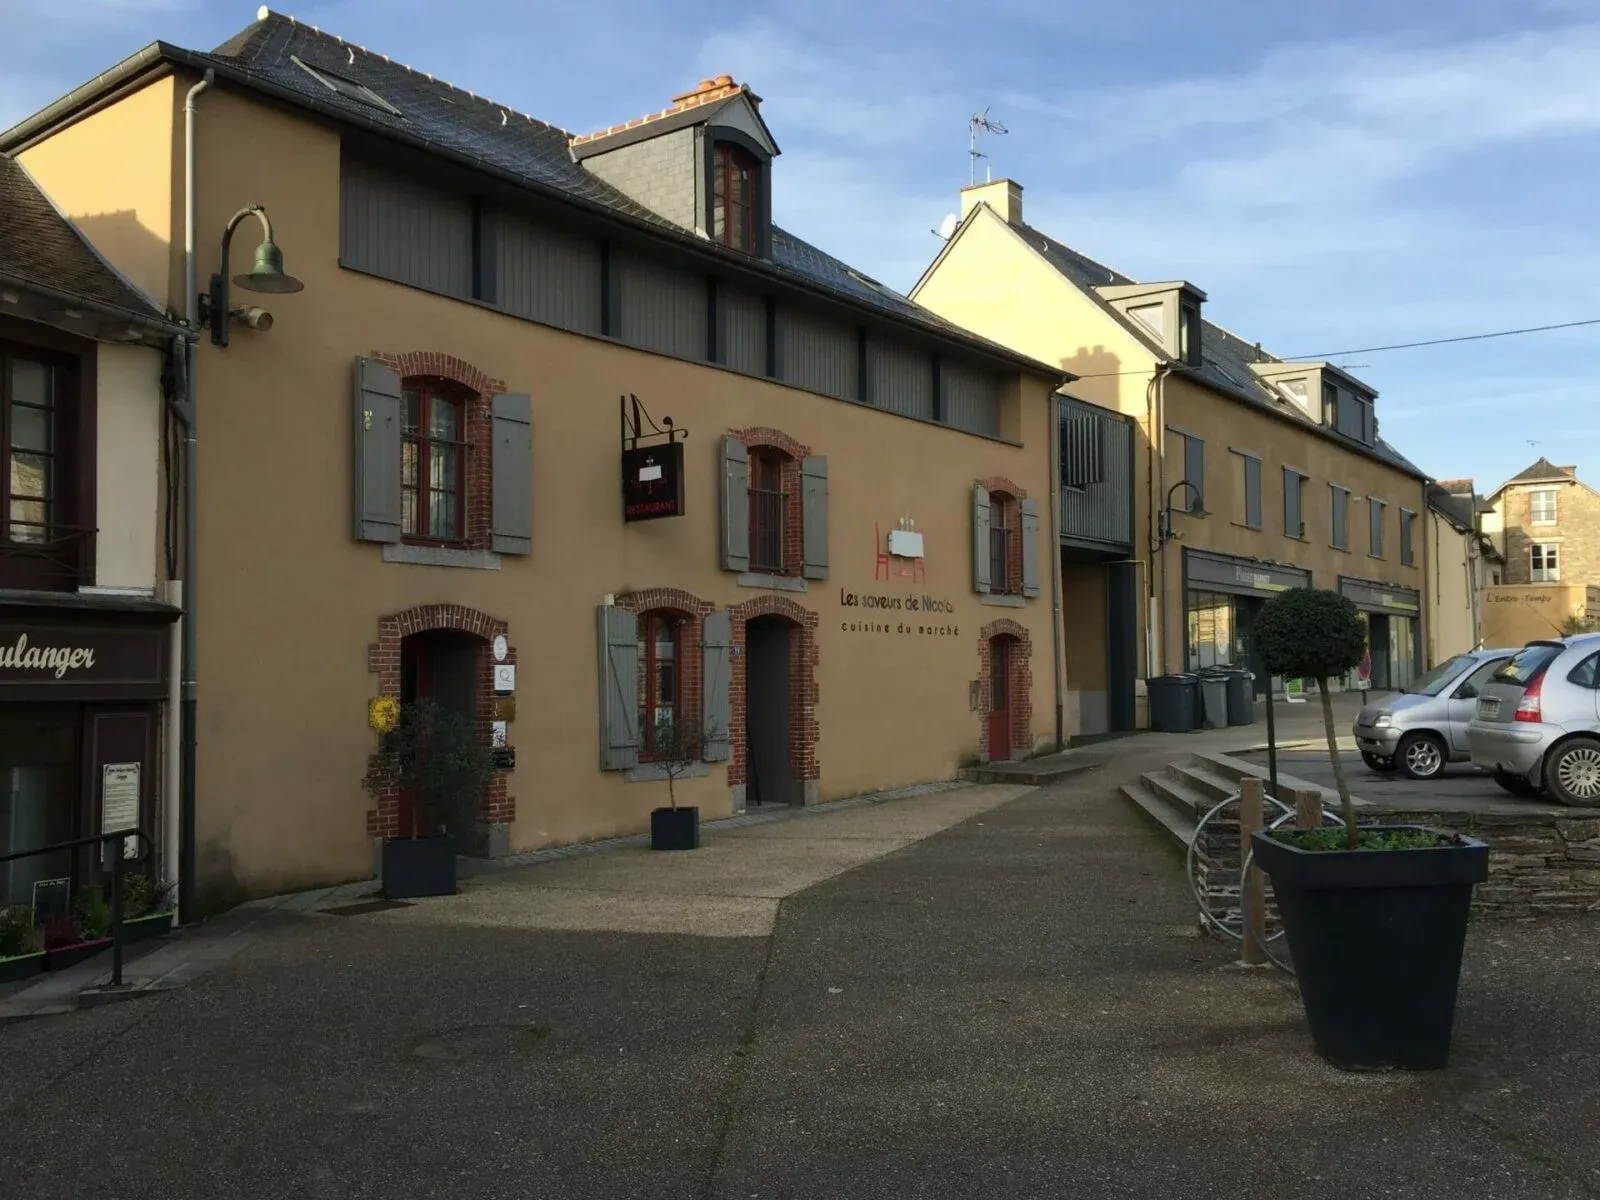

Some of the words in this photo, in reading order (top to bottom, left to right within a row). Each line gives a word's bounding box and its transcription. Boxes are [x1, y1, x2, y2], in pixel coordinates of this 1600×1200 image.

[841, 587, 858, 607] Les
[862, 594, 902, 611] saveurs
[905, 594, 919, 611] de
[841, 621, 890, 634] cuisine
[897, 622, 912, 634] du
[918, 624, 959, 637] marché
